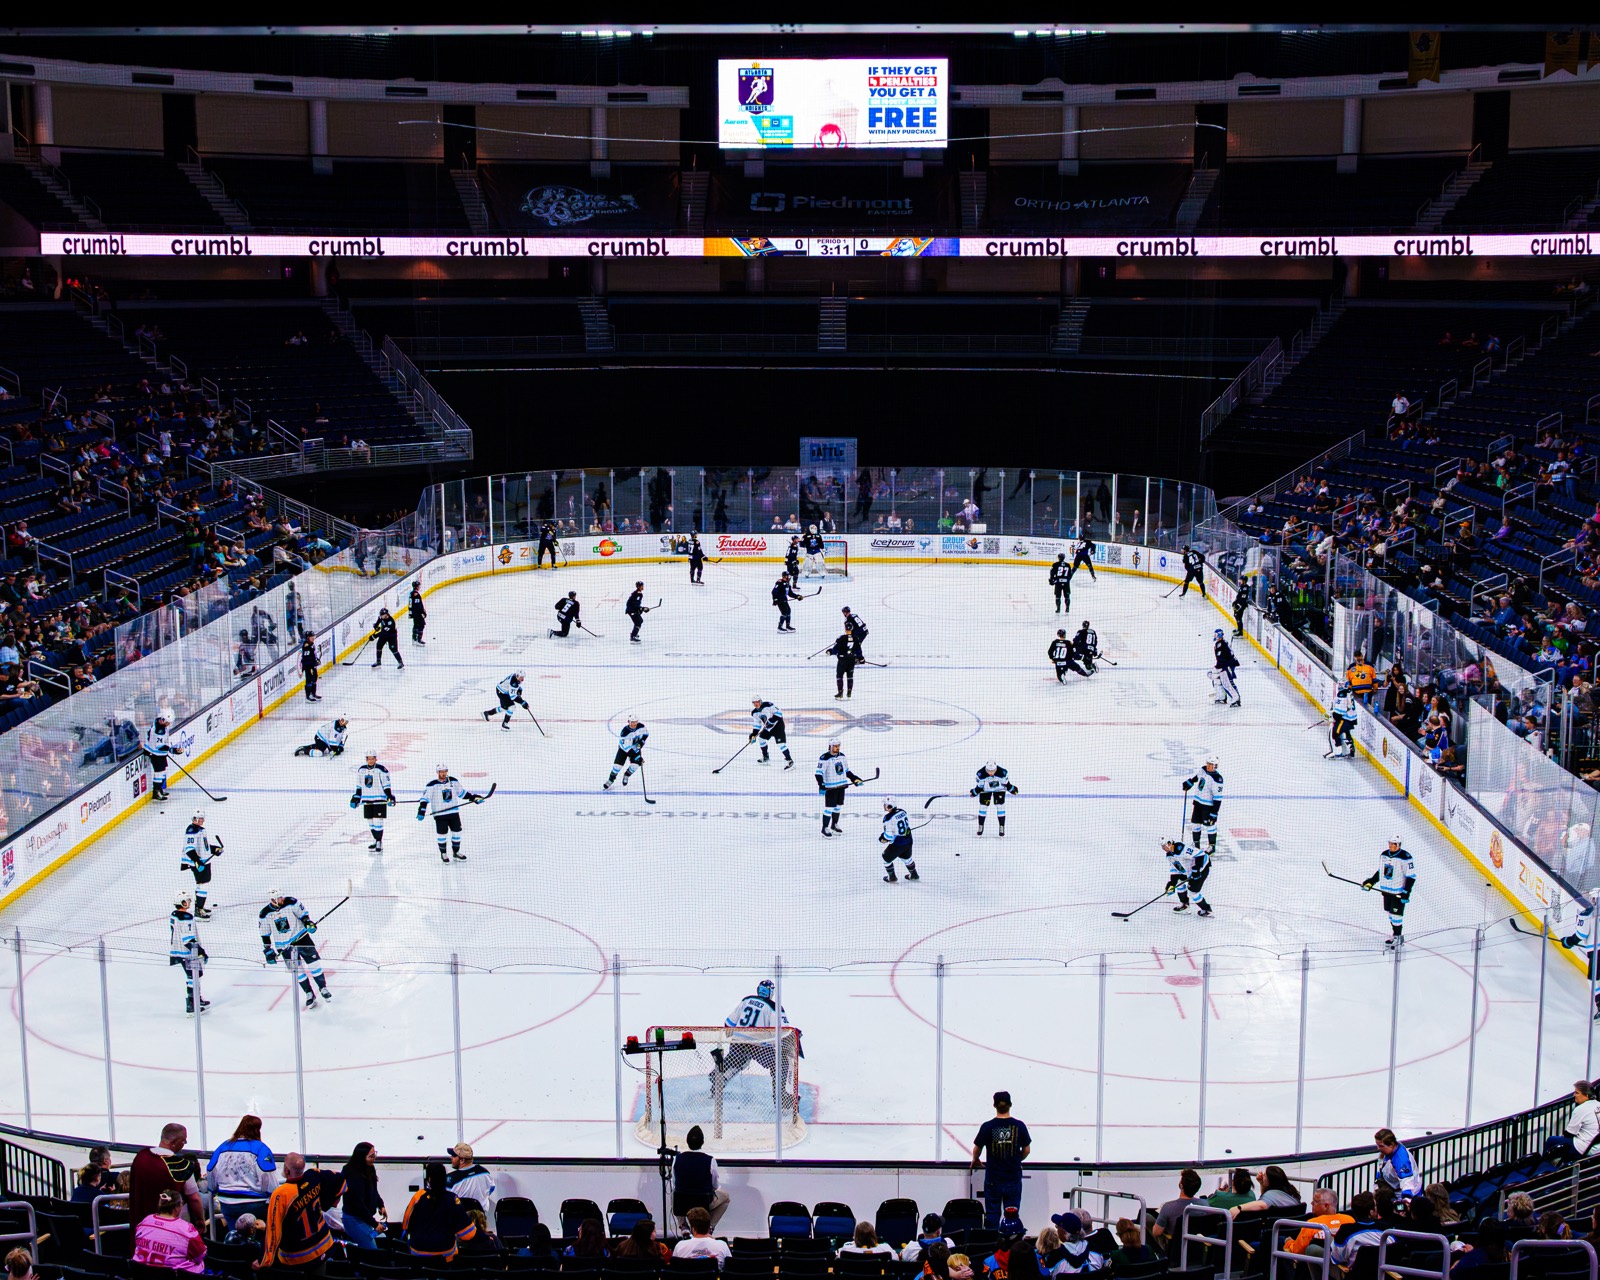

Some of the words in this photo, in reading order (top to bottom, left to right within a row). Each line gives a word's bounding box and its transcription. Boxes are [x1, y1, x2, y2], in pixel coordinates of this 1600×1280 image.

[868, 67, 879, 75] IF
[881, 67, 911, 75] THEY
[914, 67, 937, 75] GET
[880, 77, 935, 86] PENALTIES
[869, 88, 897, 97] YOU
[899, 88, 924, 97] GET
[928, 88, 937, 97] A
[868, 107, 937, 128] FREE
[793, 195, 913, 208] Piedmont
[1014, 196, 1071, 210] ORTHO
[62, 235, 126, 255] crumbl
[171, 236, 252, 255] crumbl
[309, 237, 385, 256] crumbl
[446, 237, 528, 256] crumbl
[588, 237, 669, 256] crumbl
[795, 239, 803, 250] 0
[820, 244, 850, 255] 3:11
[860, 239, 868, 250] 0
[986, 237, 1067, 256] crumbl
[1116, 237, 1198, 256] crumbl
[1260, 236, 1338, 256] crumbl
[1394, 235, 1473, 255] crumbl
[1530, 233, 1592, 255] crumbl
[716, 535, 767, 551] Freddy's
[1057, 567, 1069, 577] 27
[1053, 647, 1067, 659] 10
[263, 663, 285, 695] crumbl
[89, 791, 112, 816] Piedmont
[740, 1006, 761, 1027] 31
[151, 1241, 176, 1256] GIRLY
